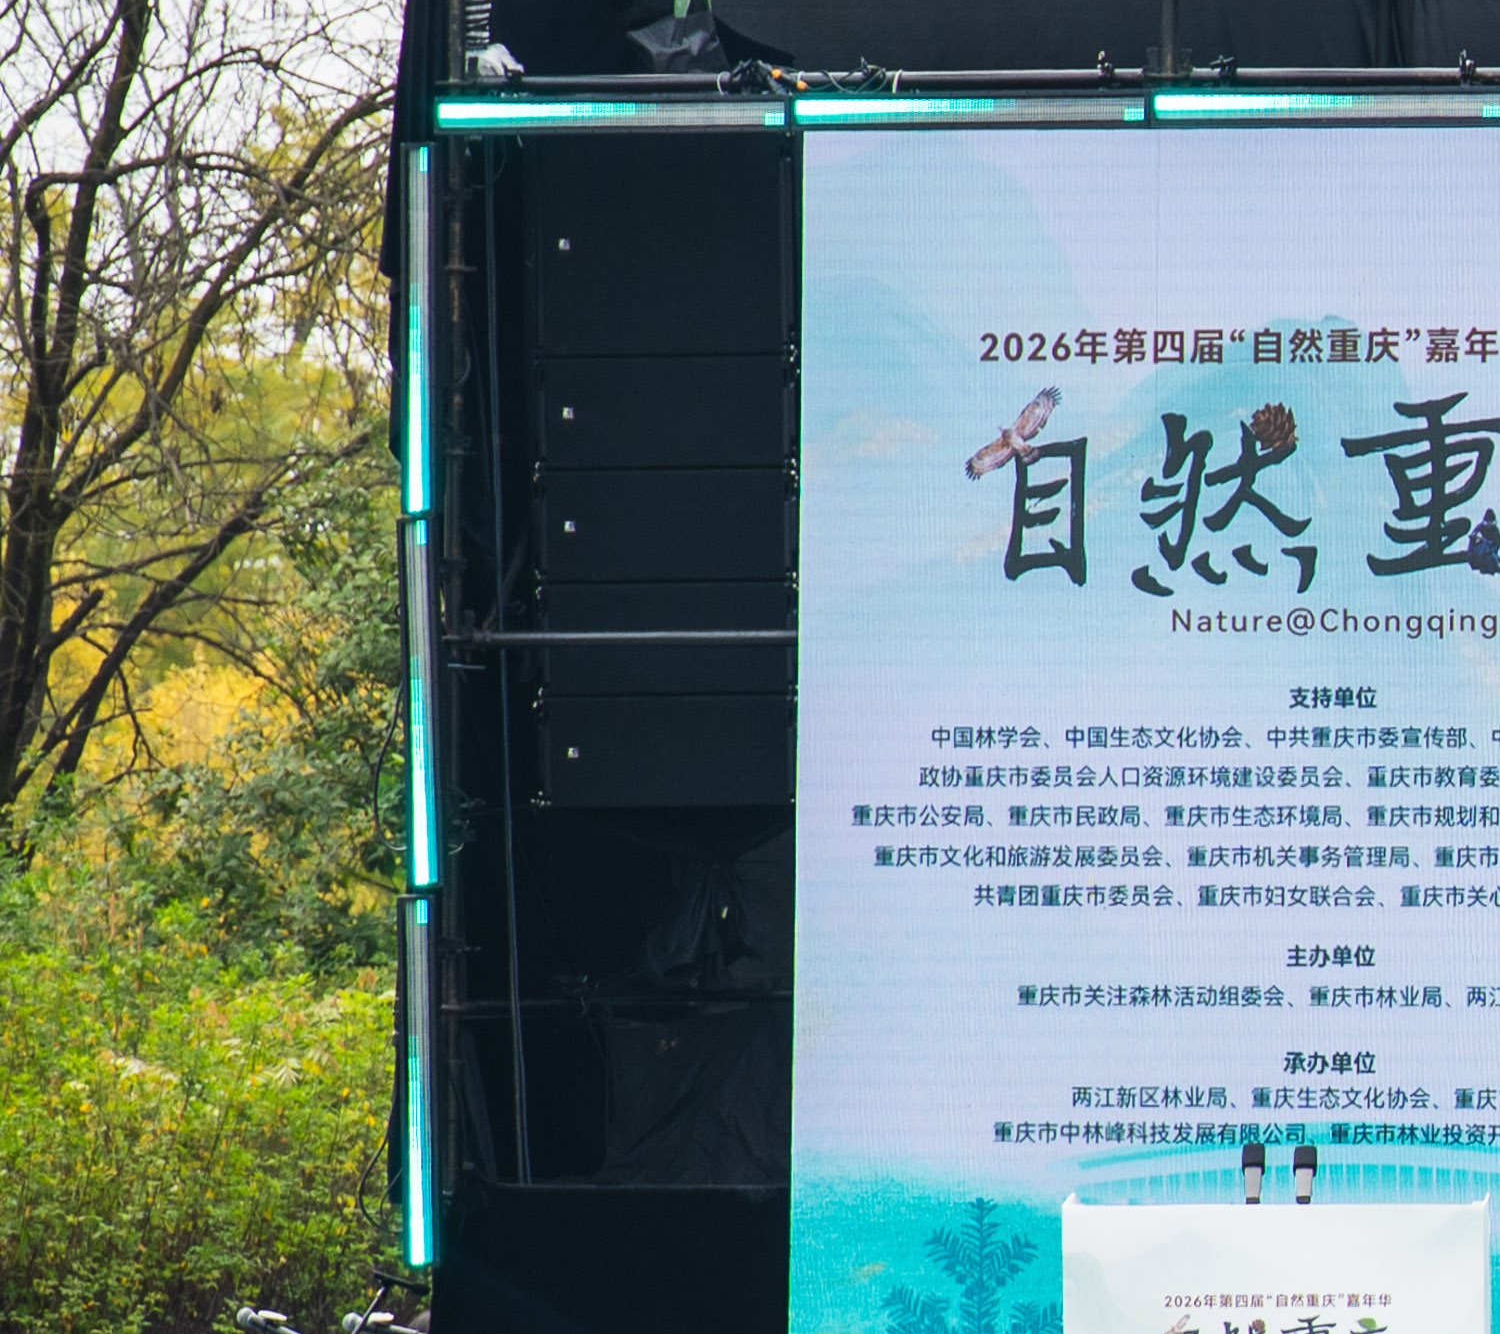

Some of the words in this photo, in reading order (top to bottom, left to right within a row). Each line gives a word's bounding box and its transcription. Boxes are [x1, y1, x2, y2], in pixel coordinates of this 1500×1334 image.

[1171, 606, 1499, 639] Nature@Chongqing
[1288, 686, 1377, 710] 支持单位
[1286, 945, 1376, 969] 主办单位
[1284, 1051, 1377, 1076] 承办单位
